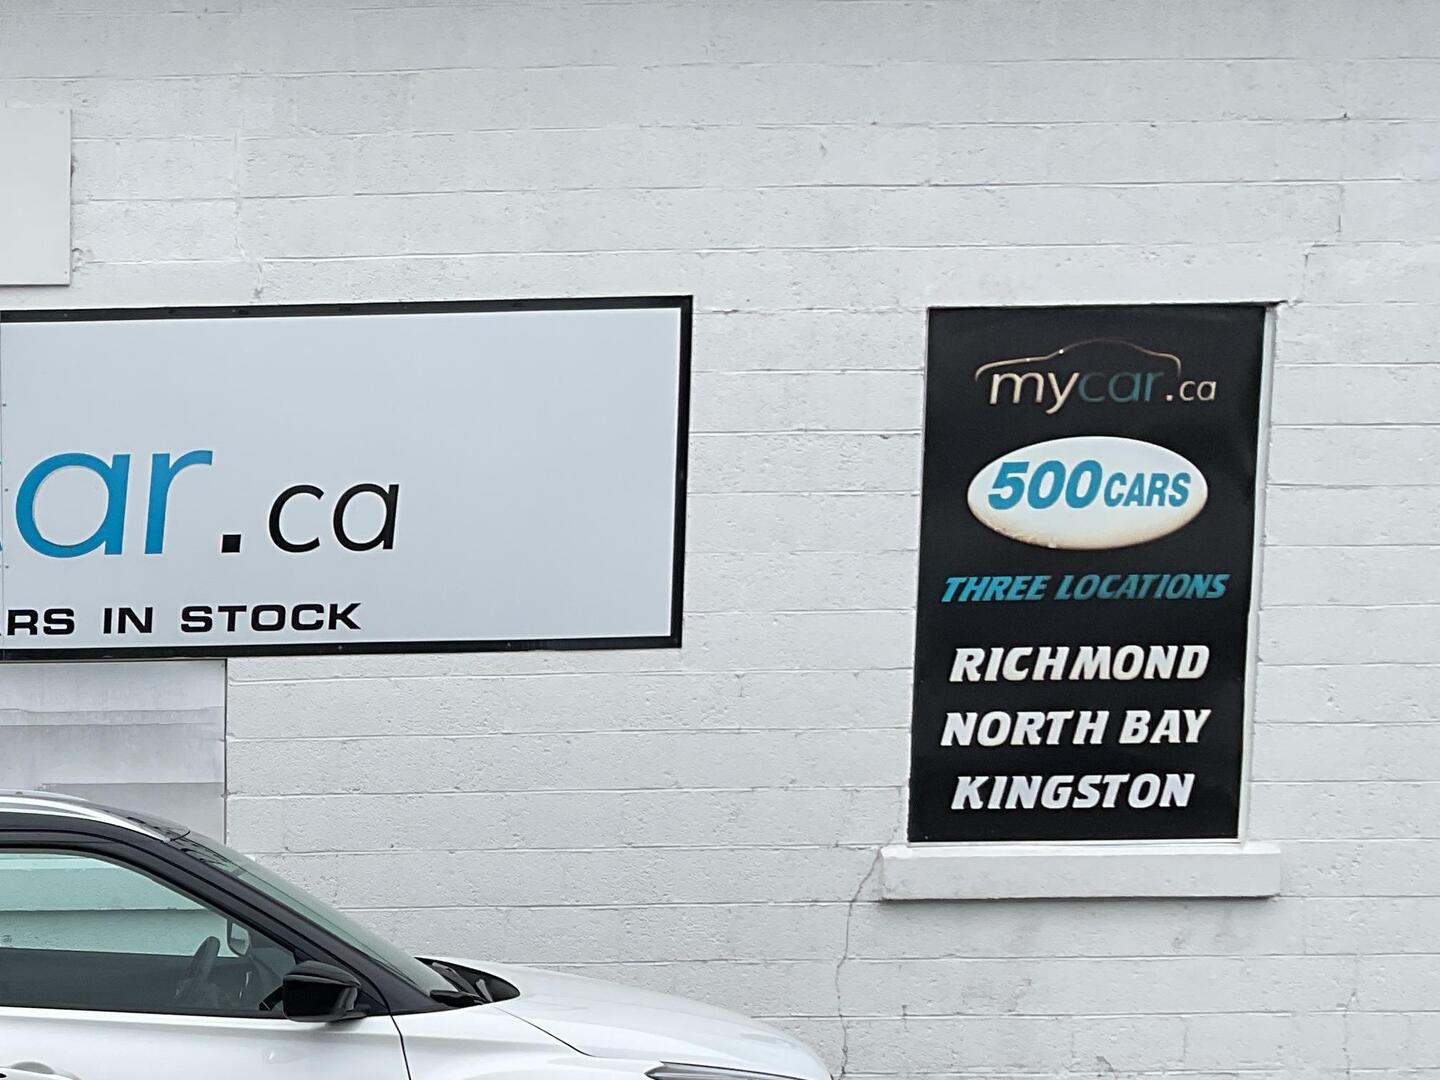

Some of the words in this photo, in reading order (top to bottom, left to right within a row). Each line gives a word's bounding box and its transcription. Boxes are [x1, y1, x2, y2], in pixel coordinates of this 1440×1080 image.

[989, 367, 1217, 414] mycar.ca
[988, 460, 1102, 510] 500
[1102, 472, 1191, 507] CARS
[942, 575, 1048, 602] THREE
[1056, 573, 1230, 600] LOCATIONS
[104, 607, 154, 633] IN
[180, 603, 361, 632] STOCK
[949, 645, 1210, 682] RICHMOND
[941, 710, 1111, 745] NORTH
[1119, 708, 1211, 744] BAY
[951, 773, 1195, 810] KINGSTON
